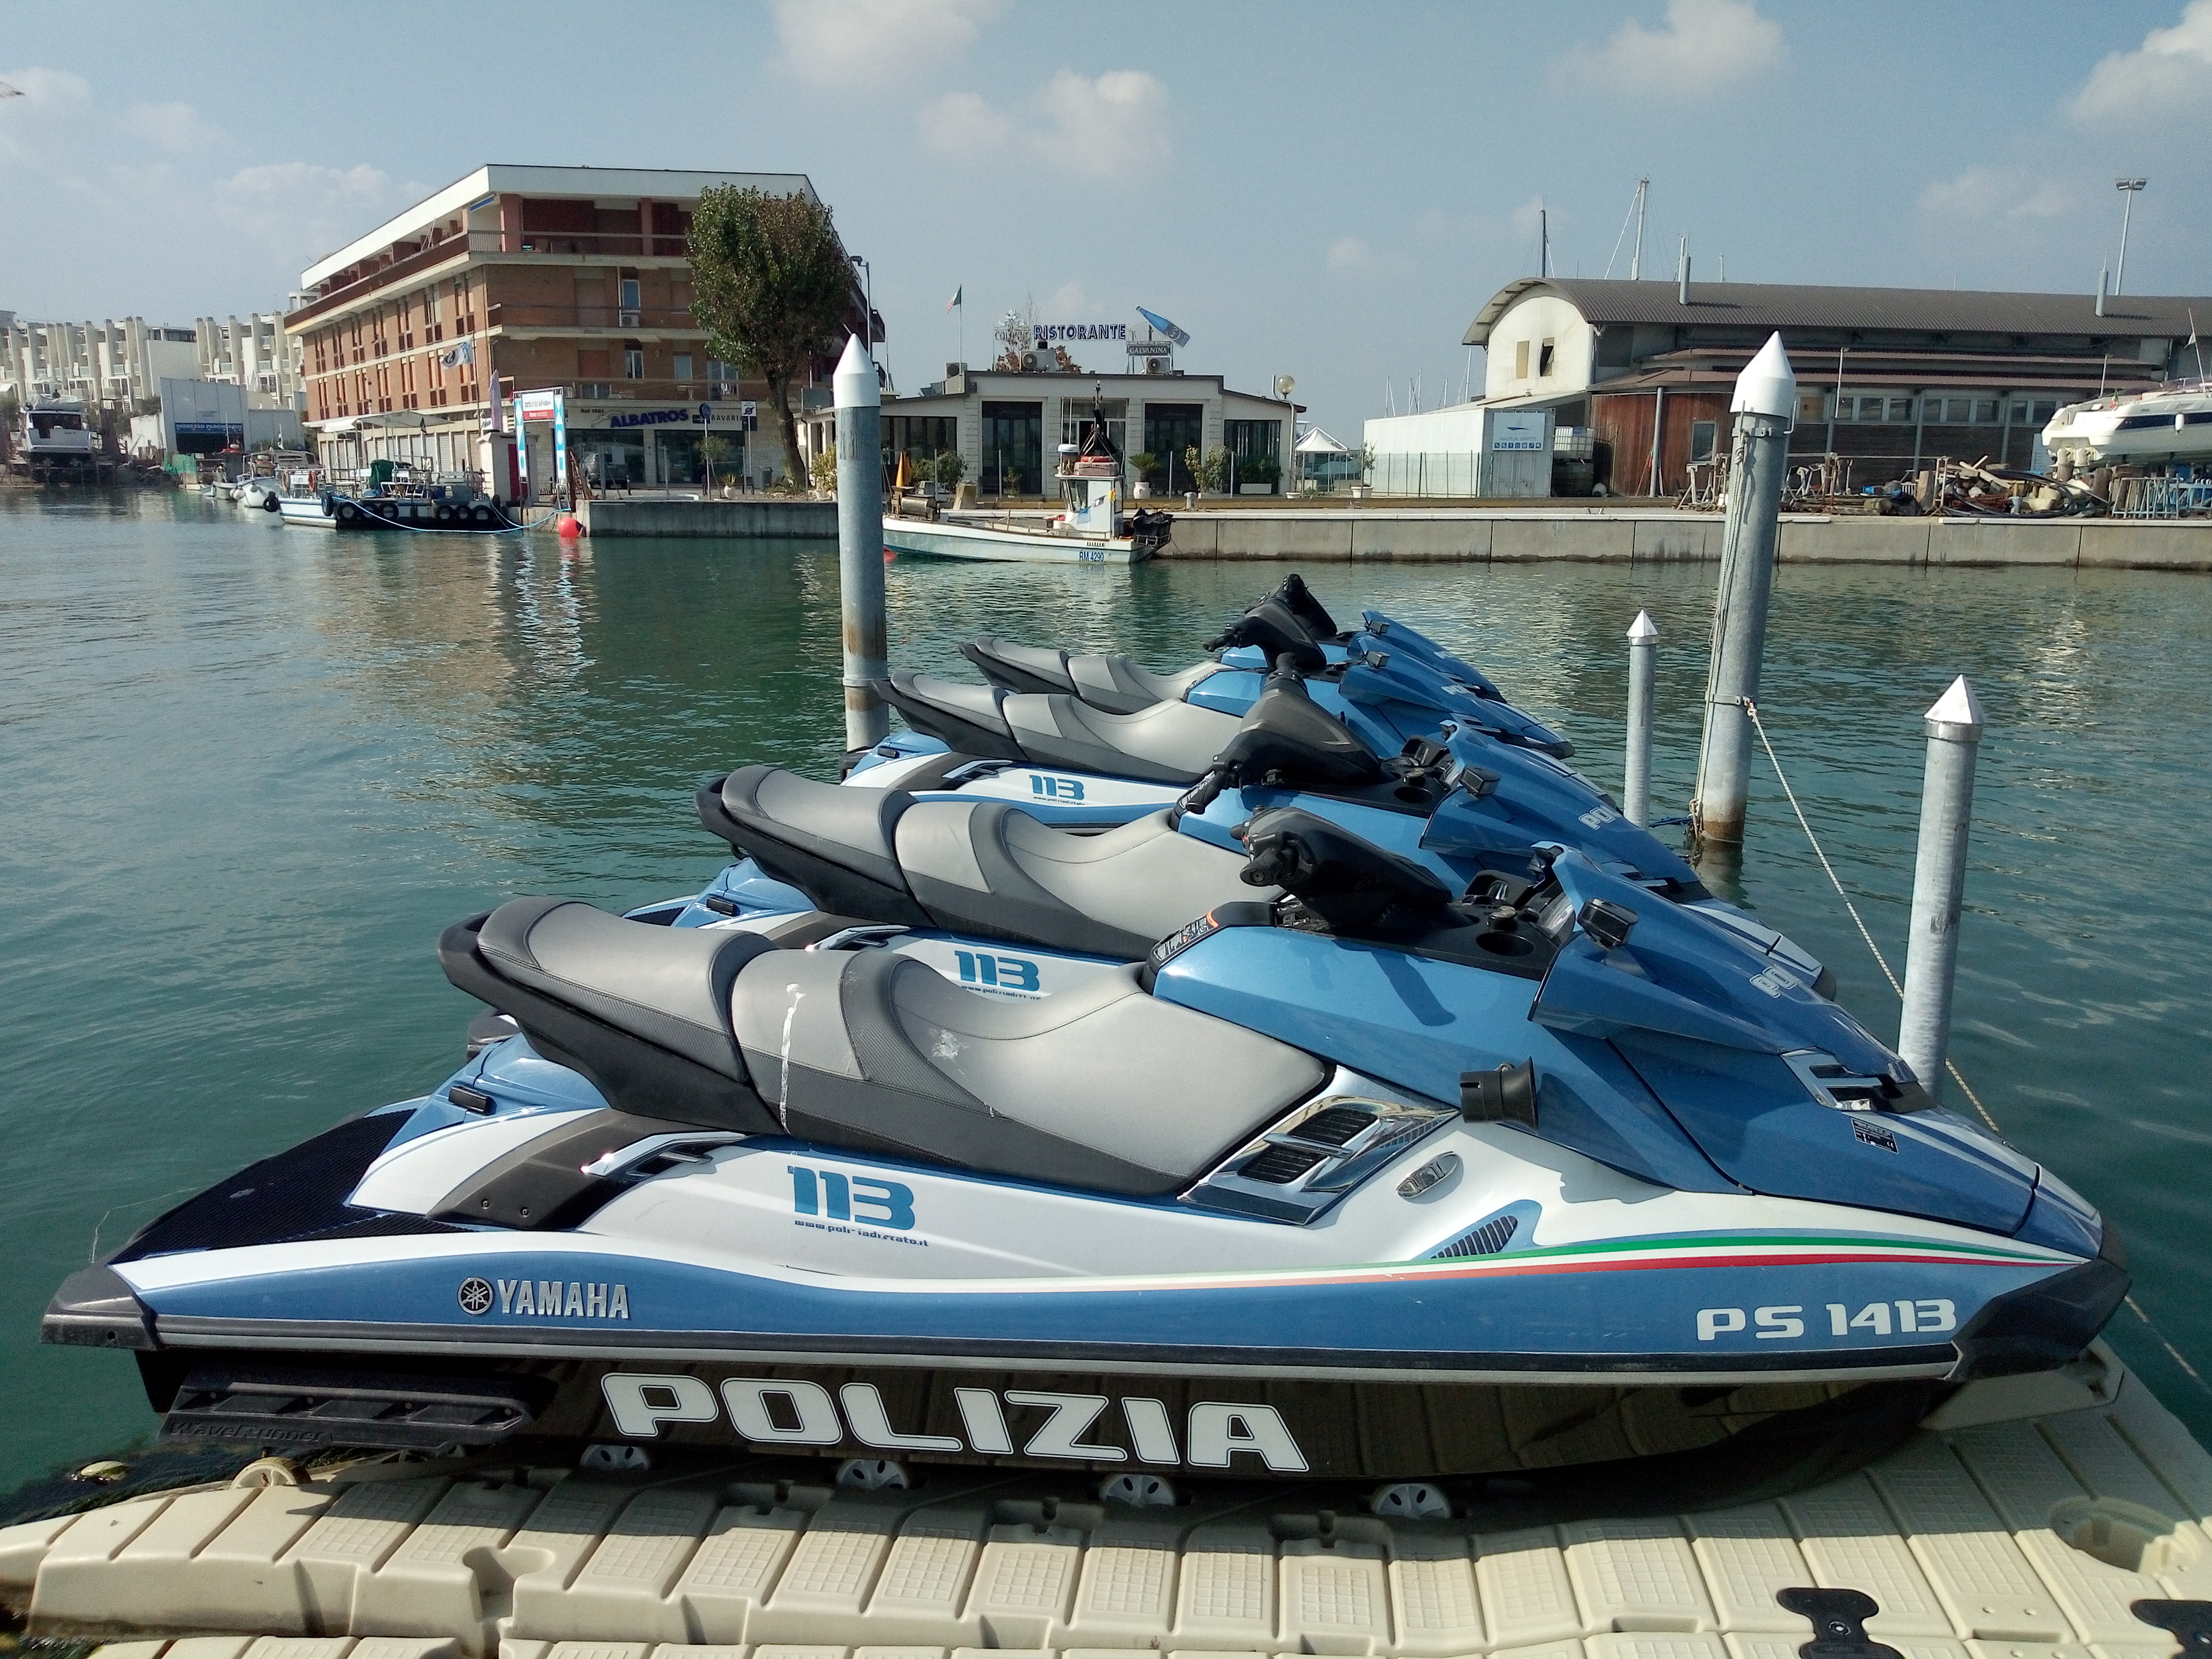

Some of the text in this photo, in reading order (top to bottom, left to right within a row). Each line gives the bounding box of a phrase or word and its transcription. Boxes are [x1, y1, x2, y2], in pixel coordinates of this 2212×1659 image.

[1034, 324, 1126, 340] RISTORANTE
[610, 409, 689, 428] ALBATROS
[1079, 551, 1104, 562] RM 4290
[1029, 775, 1085, 801] 113
[954, 950, 1040, 992] 113
[787, 1165, 916, 1230] 113
[497, 1279, 630, 1319] YAMAHA
[1696, 1298, 1957, 1341] PS 1413
[601, 1372, 1311, 1472] POLIZIA
